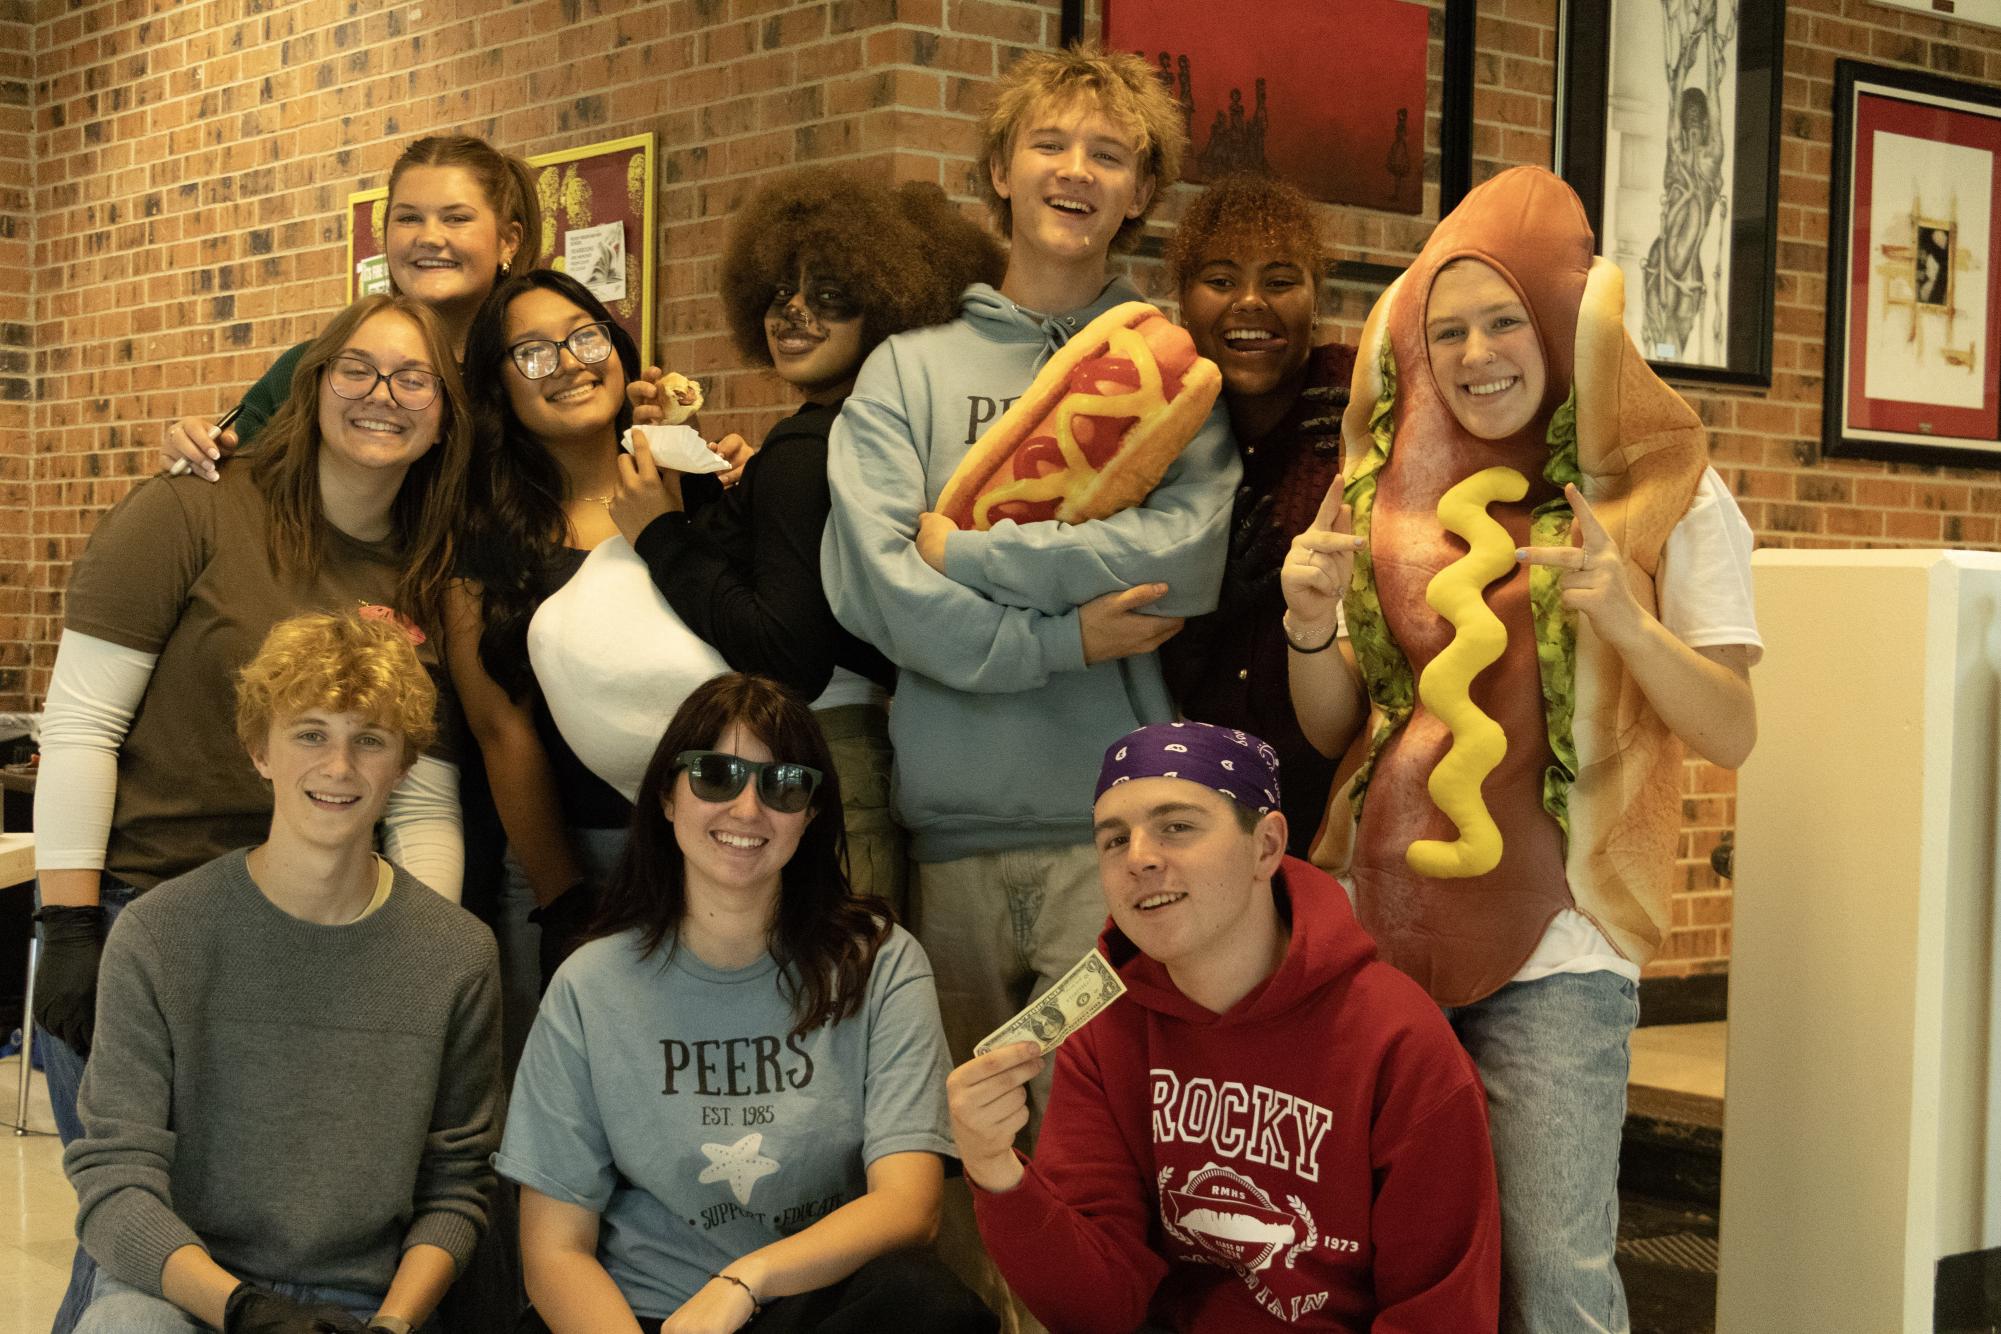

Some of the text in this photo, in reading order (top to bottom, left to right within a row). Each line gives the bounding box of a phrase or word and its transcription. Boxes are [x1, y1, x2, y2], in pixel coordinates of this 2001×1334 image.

[659, 1031, 815, 1097] PEERS
[702, 1104, 775, 1126] EST. 1985
[1150, 1068, 1334, 1183] ROCKY
[1211, 1185, 1246, 1200] RMHS
[1324, 1235, 1360, 1252] 1973
